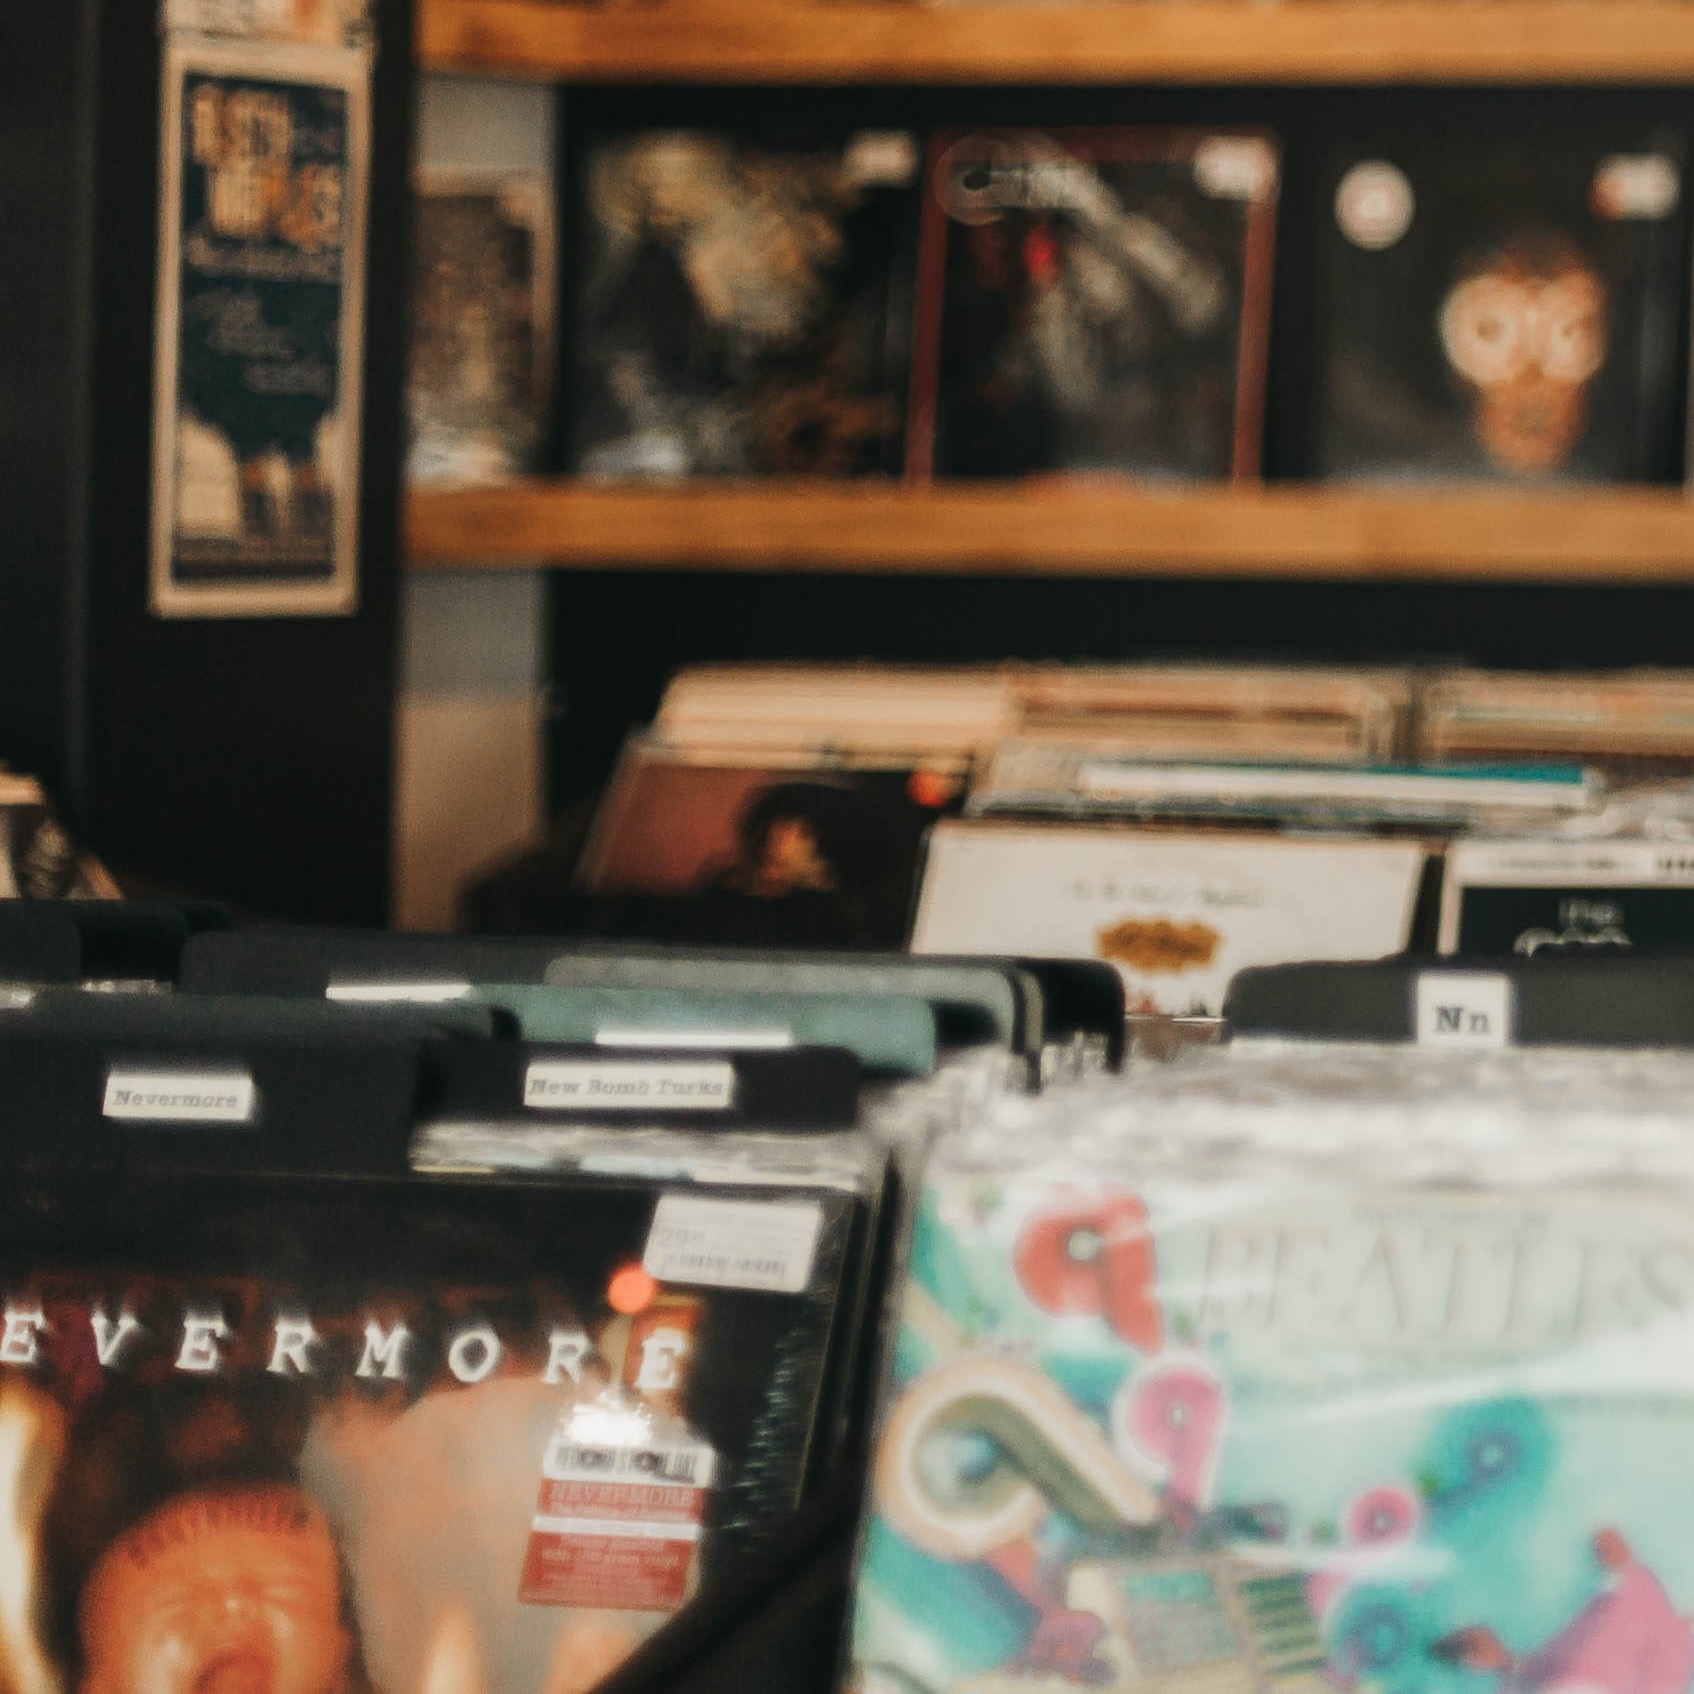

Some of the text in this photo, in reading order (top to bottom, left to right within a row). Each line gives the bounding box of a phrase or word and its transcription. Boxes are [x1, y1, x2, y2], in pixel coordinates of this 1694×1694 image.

[1433, 1004, 1490, 1036] Nn
[112, 1087, 240, 1111] Nevermore
[529, 1077, 582, 1099] New
[655, 1077, 726, 1099] Turks
